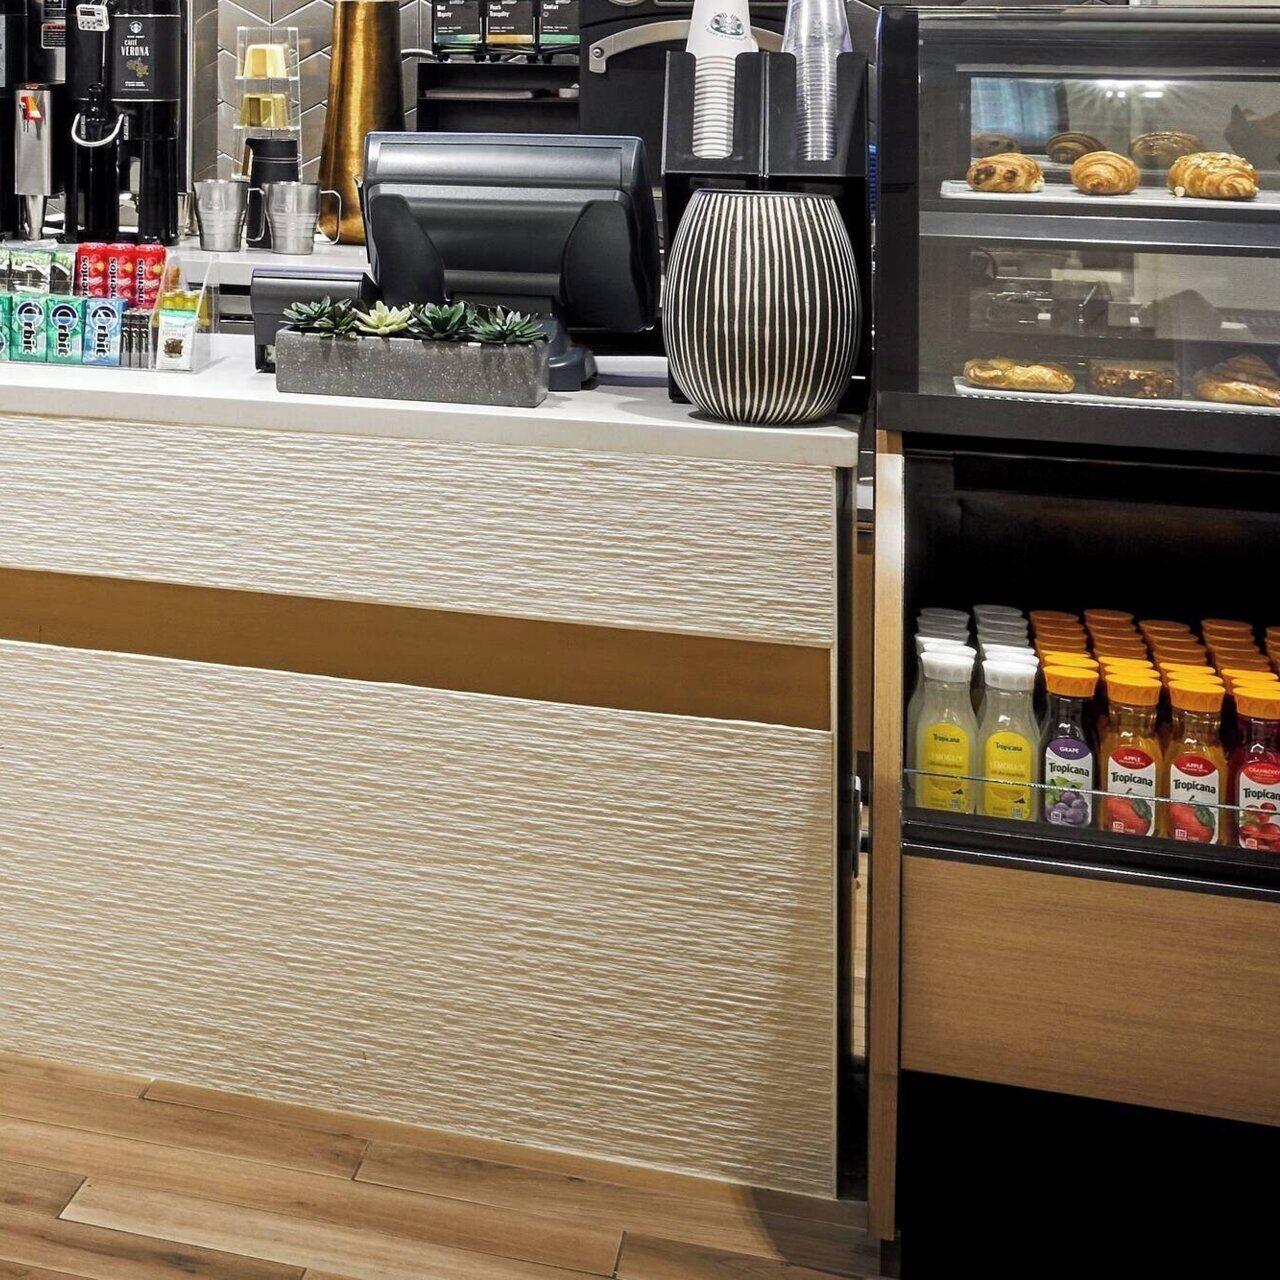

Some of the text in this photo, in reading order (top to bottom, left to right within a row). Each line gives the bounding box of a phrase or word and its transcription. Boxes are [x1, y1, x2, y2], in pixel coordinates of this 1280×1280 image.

[121, 46, 150, 56] VERONA
[137, 259, 145, 303] mentos
[16, 301, 44, 354] Orbit
[50, 304, 79, 357] Orbit
[90, 305, 118, 357] Orbit
[1059, 746, 1080, 754] GRAPE
[1049, 762, 1090, 777] Tropicana
[1111, 771, 1153, 787] Tropicana
[1173, 779, 1216, 794] Tropicana
